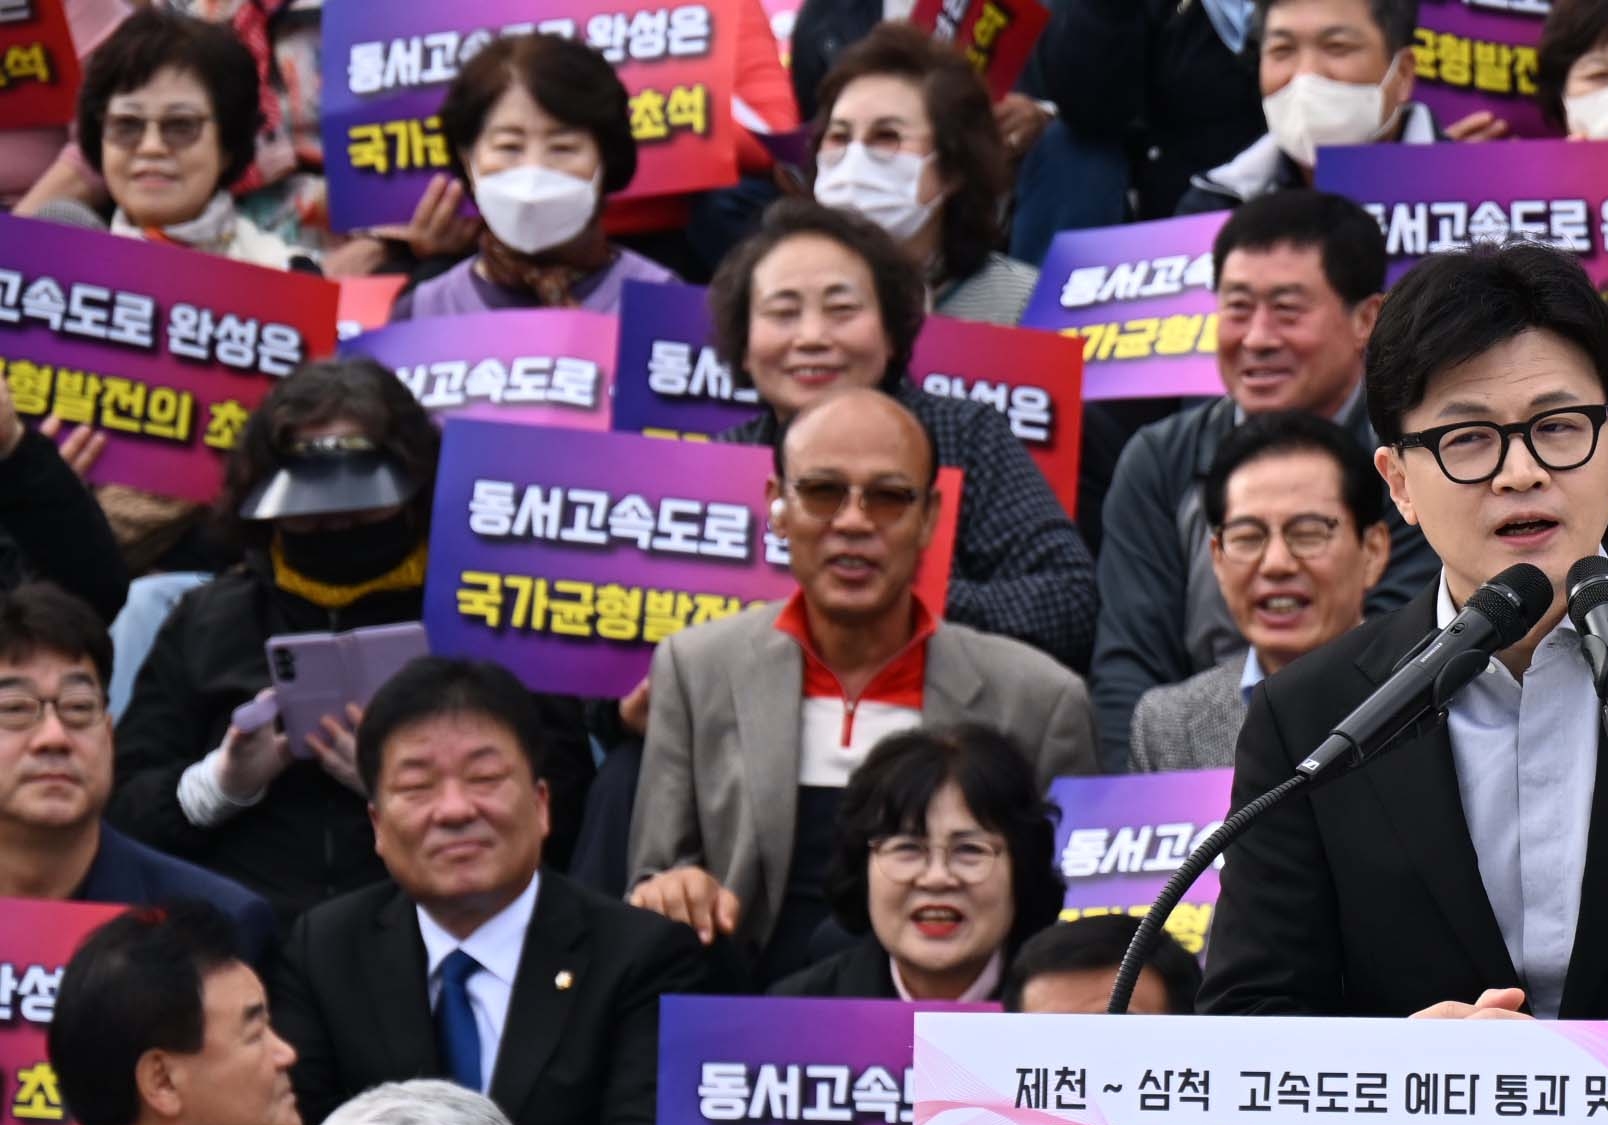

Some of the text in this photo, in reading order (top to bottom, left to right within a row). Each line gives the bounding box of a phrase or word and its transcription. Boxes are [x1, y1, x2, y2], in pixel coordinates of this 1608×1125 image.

[0, 42, 49, 87] 석
[347, 20, 576, 94] 동서고
[629, 85, 707, 140] 초석
[1363, 200, 1591, 254] 서고속도로
[167, 302, 301, 377] 완성은
[1058, 314, 1218, 362] 가균형
[0, 355, 193, 441] 형발전의
[469, 480, 750, 558] 동서고속도로
[456, 571, 768, 644] 국가균형발
[698, 1062, 914, 1124] 동서고속
[1014, 1066, 1087, 1110] 제천
[1138, 1068, 1210, 1112] 삼척
[1238, 1071, 1388, 1113] 고속도로
[1405, 1072, 1480, 1115] 예타
[1494, 1074, 1570, 1117] 통과
